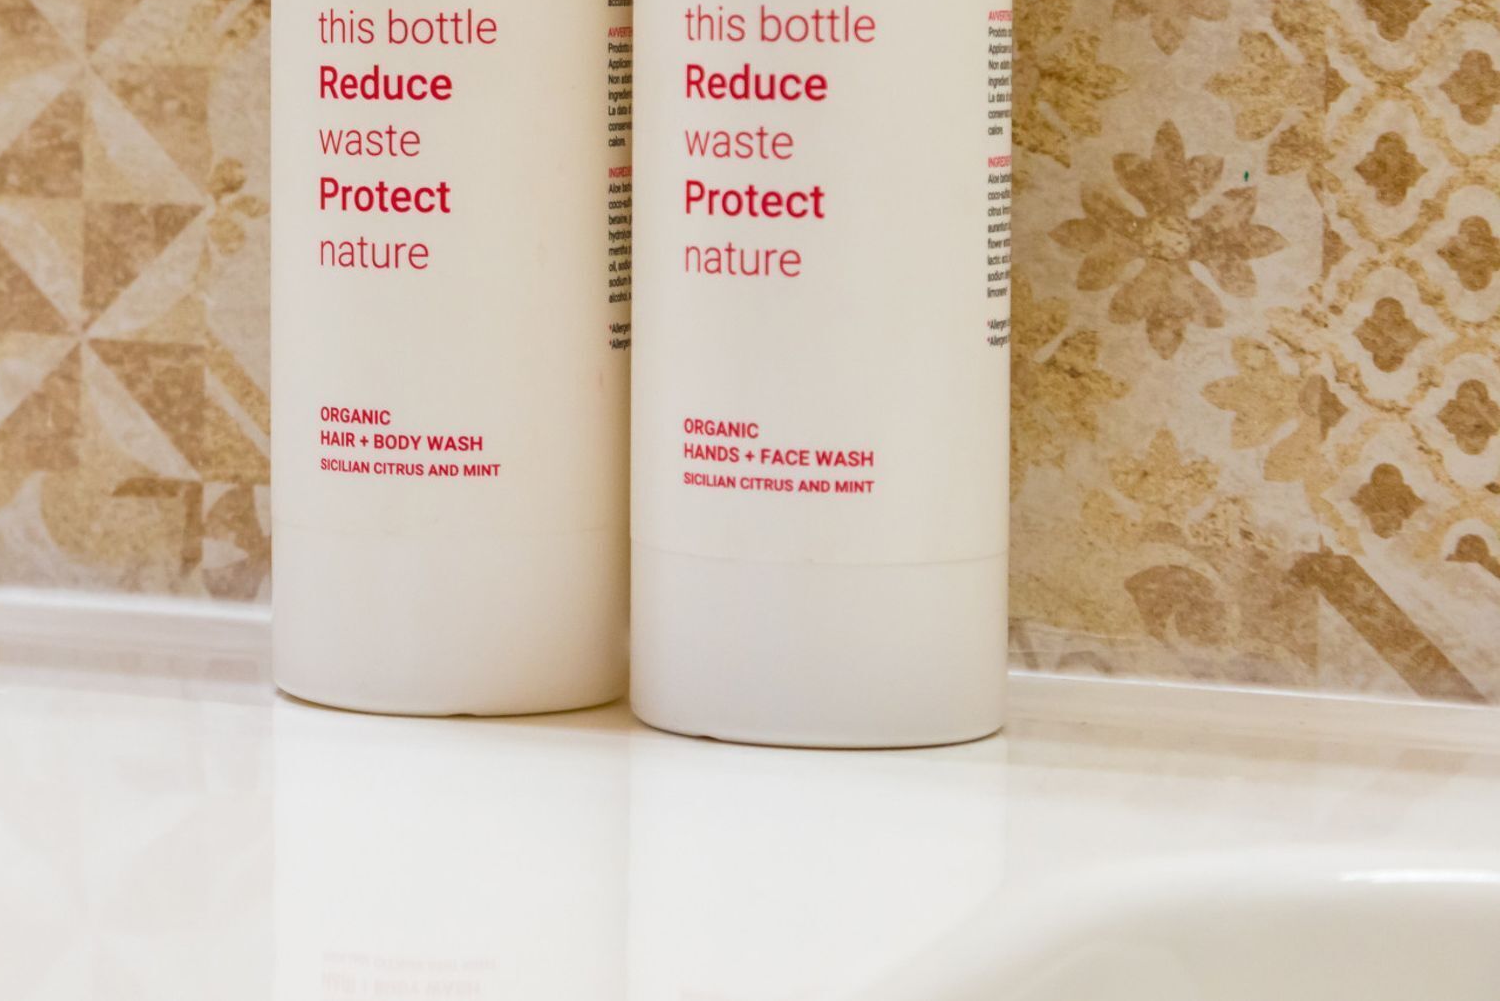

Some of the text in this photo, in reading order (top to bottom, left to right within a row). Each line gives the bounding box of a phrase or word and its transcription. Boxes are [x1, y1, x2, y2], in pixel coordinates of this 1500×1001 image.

[319, 9, 496, 44] this bottle
[685, 5, 875, 43] this bottle
[321, 65, 452, 100] Reduce
[687, 64, 827, 101] Reduce
[320, 125, 420, 156] waste
[686, 127, 793, 160] waste
[321, 177, 450, 213] Protect
[686, 180, 824, 218] Protect
[321, 237, 428, 269] nature
[686, 242, 801, 277] nature
[321, 407, 390, 425] ORGANIC
[684, 418, 758, 439] ORGANIC
[321, 431, 482, 451] HAIR + BODY WASH
[685, 443, 873, 467] HANDS + FACE WASH
[321, 458, 500, 476] SICILIAN CITRUS AND MINT
[684, 472, 874, 492] SICILIAN CITRUS AND MINT
